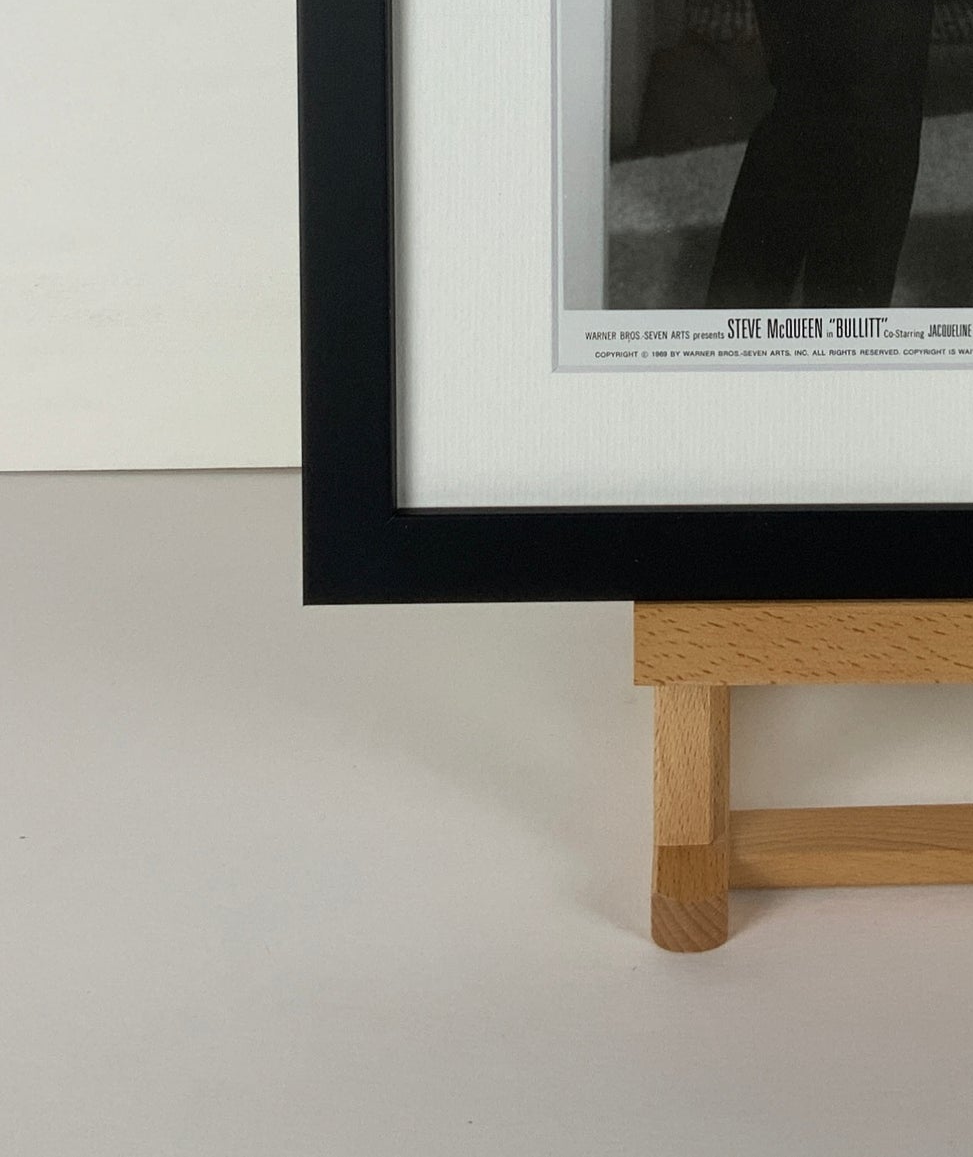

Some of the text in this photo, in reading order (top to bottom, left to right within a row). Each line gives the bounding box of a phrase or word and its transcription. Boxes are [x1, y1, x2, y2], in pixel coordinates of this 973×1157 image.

[584, 331, 617, 340] WARNER
[670, 330, 691, 340] ARTS
[692, 331, 726, 341] presents
[727, 318, 763, 340] STEVE
[766, 317, 823, 339] McQUEEN
[826, 330, 834, 338] in
[883, 329, 925, 339] Co-Starring
[927, 324, 973, 337] JACQUELINE
[594, 350, 639, 359] COPYRIGHT
[669, 350, 681, 358] BY
[682, 349, 716, 358] WARNER
[793, 348, 810, 357] INC.
[811, 348, 827, 357] ALL
[828, 348, 857, 357] RIGHTS
[902, 348, 947, 356] COPYRIGHT
[948, 348, 957, 356] IS
